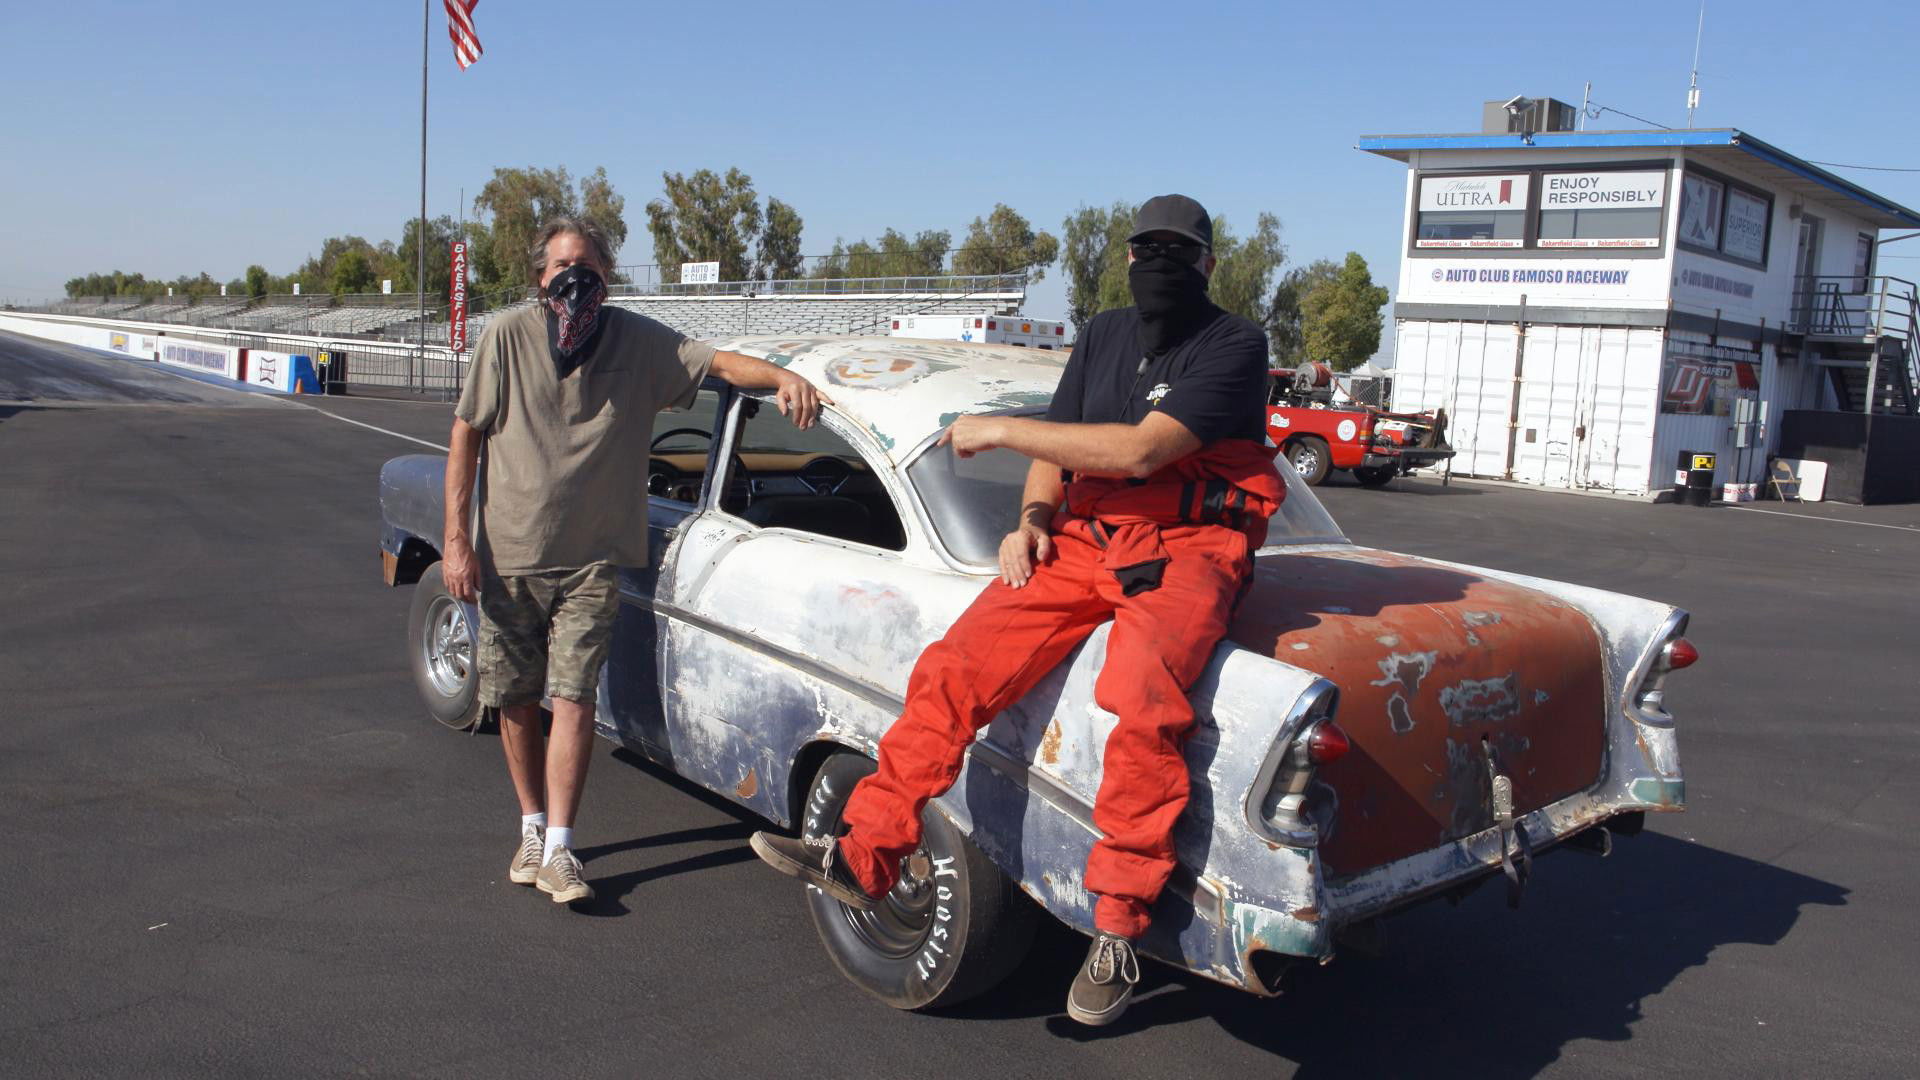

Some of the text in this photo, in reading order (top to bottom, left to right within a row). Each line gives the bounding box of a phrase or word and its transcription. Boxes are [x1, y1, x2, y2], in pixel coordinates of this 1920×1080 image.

[1550, 177, 1600, 190] ENJOY
[1436, 191, 1493, 206] ULTRA
[1548, 190, 1657, 204] RESPONSIBLY
[690, 264, 708, 273] AUTO
[690, 273, 708, 281] CLUB
[1446, 269, 1629, 284] AUTO CLUB FAMOSO RACEWAY
[453, 244, 465, 351] BAKERSFIELD
[1701, 366, 1731, 377] SAFETY
[916, 855, 959, 981] Hoosier
